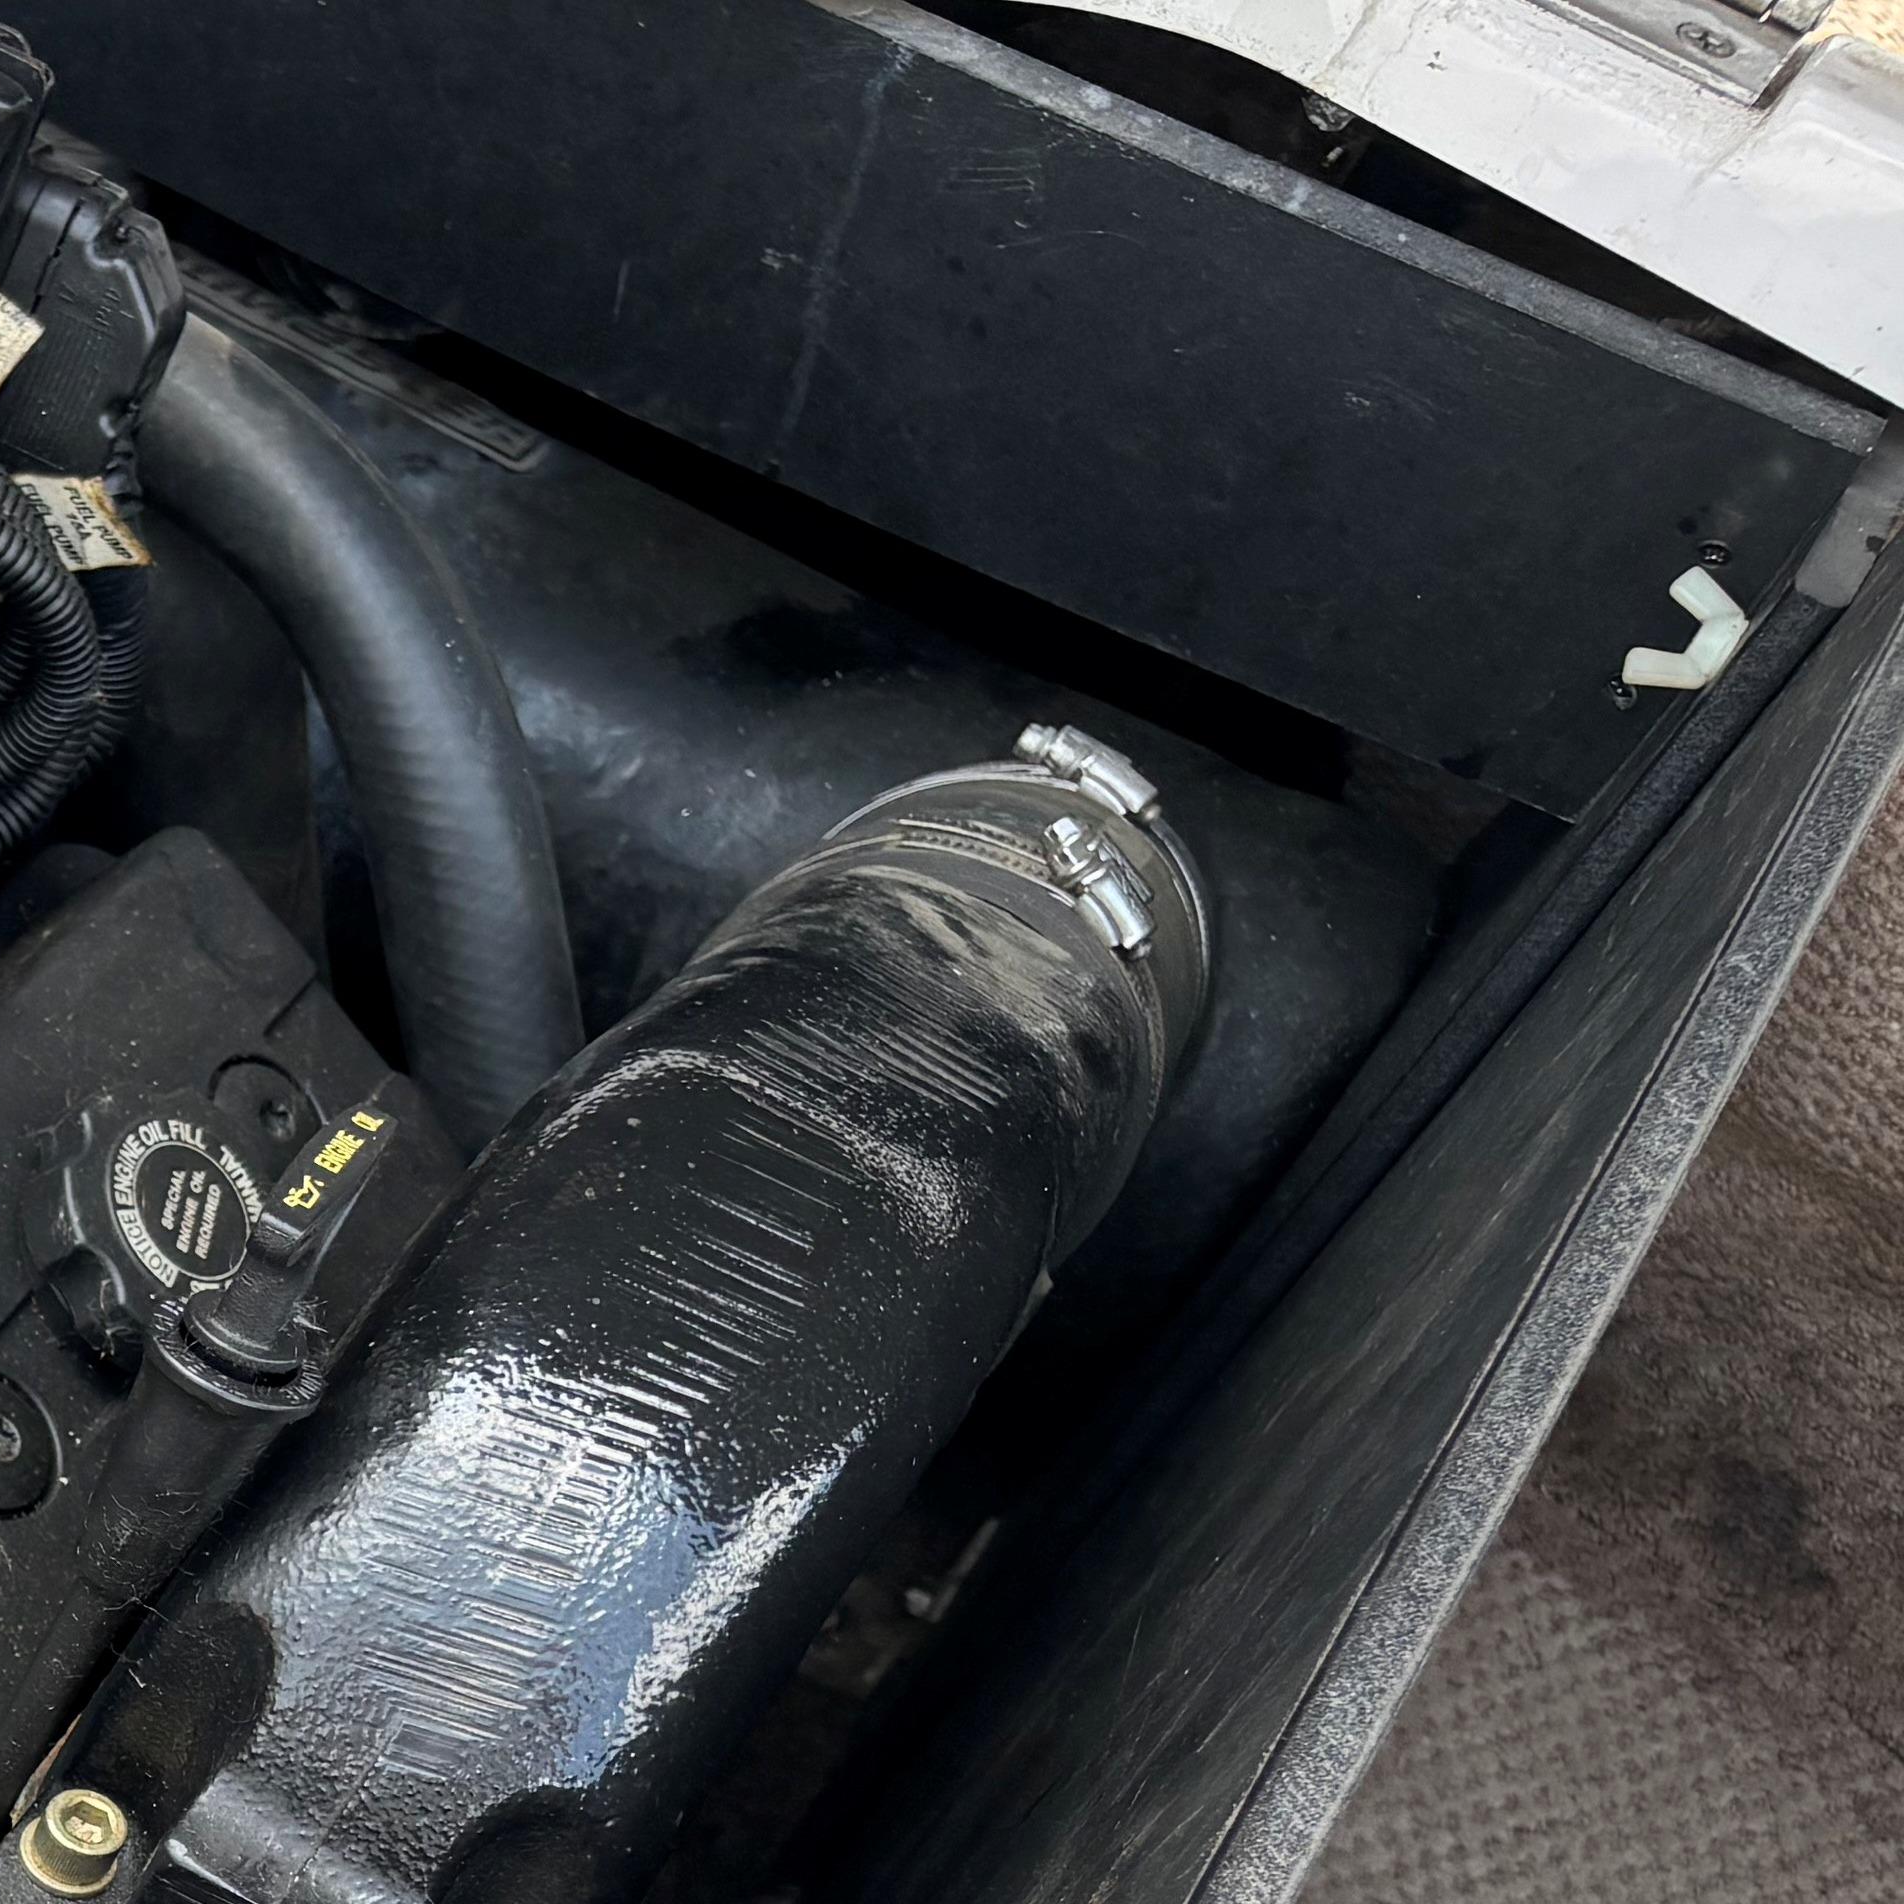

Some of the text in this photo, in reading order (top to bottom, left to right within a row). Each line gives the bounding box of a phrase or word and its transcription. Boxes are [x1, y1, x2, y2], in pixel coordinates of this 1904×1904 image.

[45, 524, 84, 565] PUMP
[63, 486, 133, 559] FUEL PUMP
[313, 1110, 385, 1174] ENGINE OIL
[113, 1119, 208, 1288] NOTICE ENGINE OIL FILL
[160, 1170, 187, 1231] SPECIAL
[189, 1170, 207, 1194] OIL
[194, 1184, 222, 1260] REQUIRED
